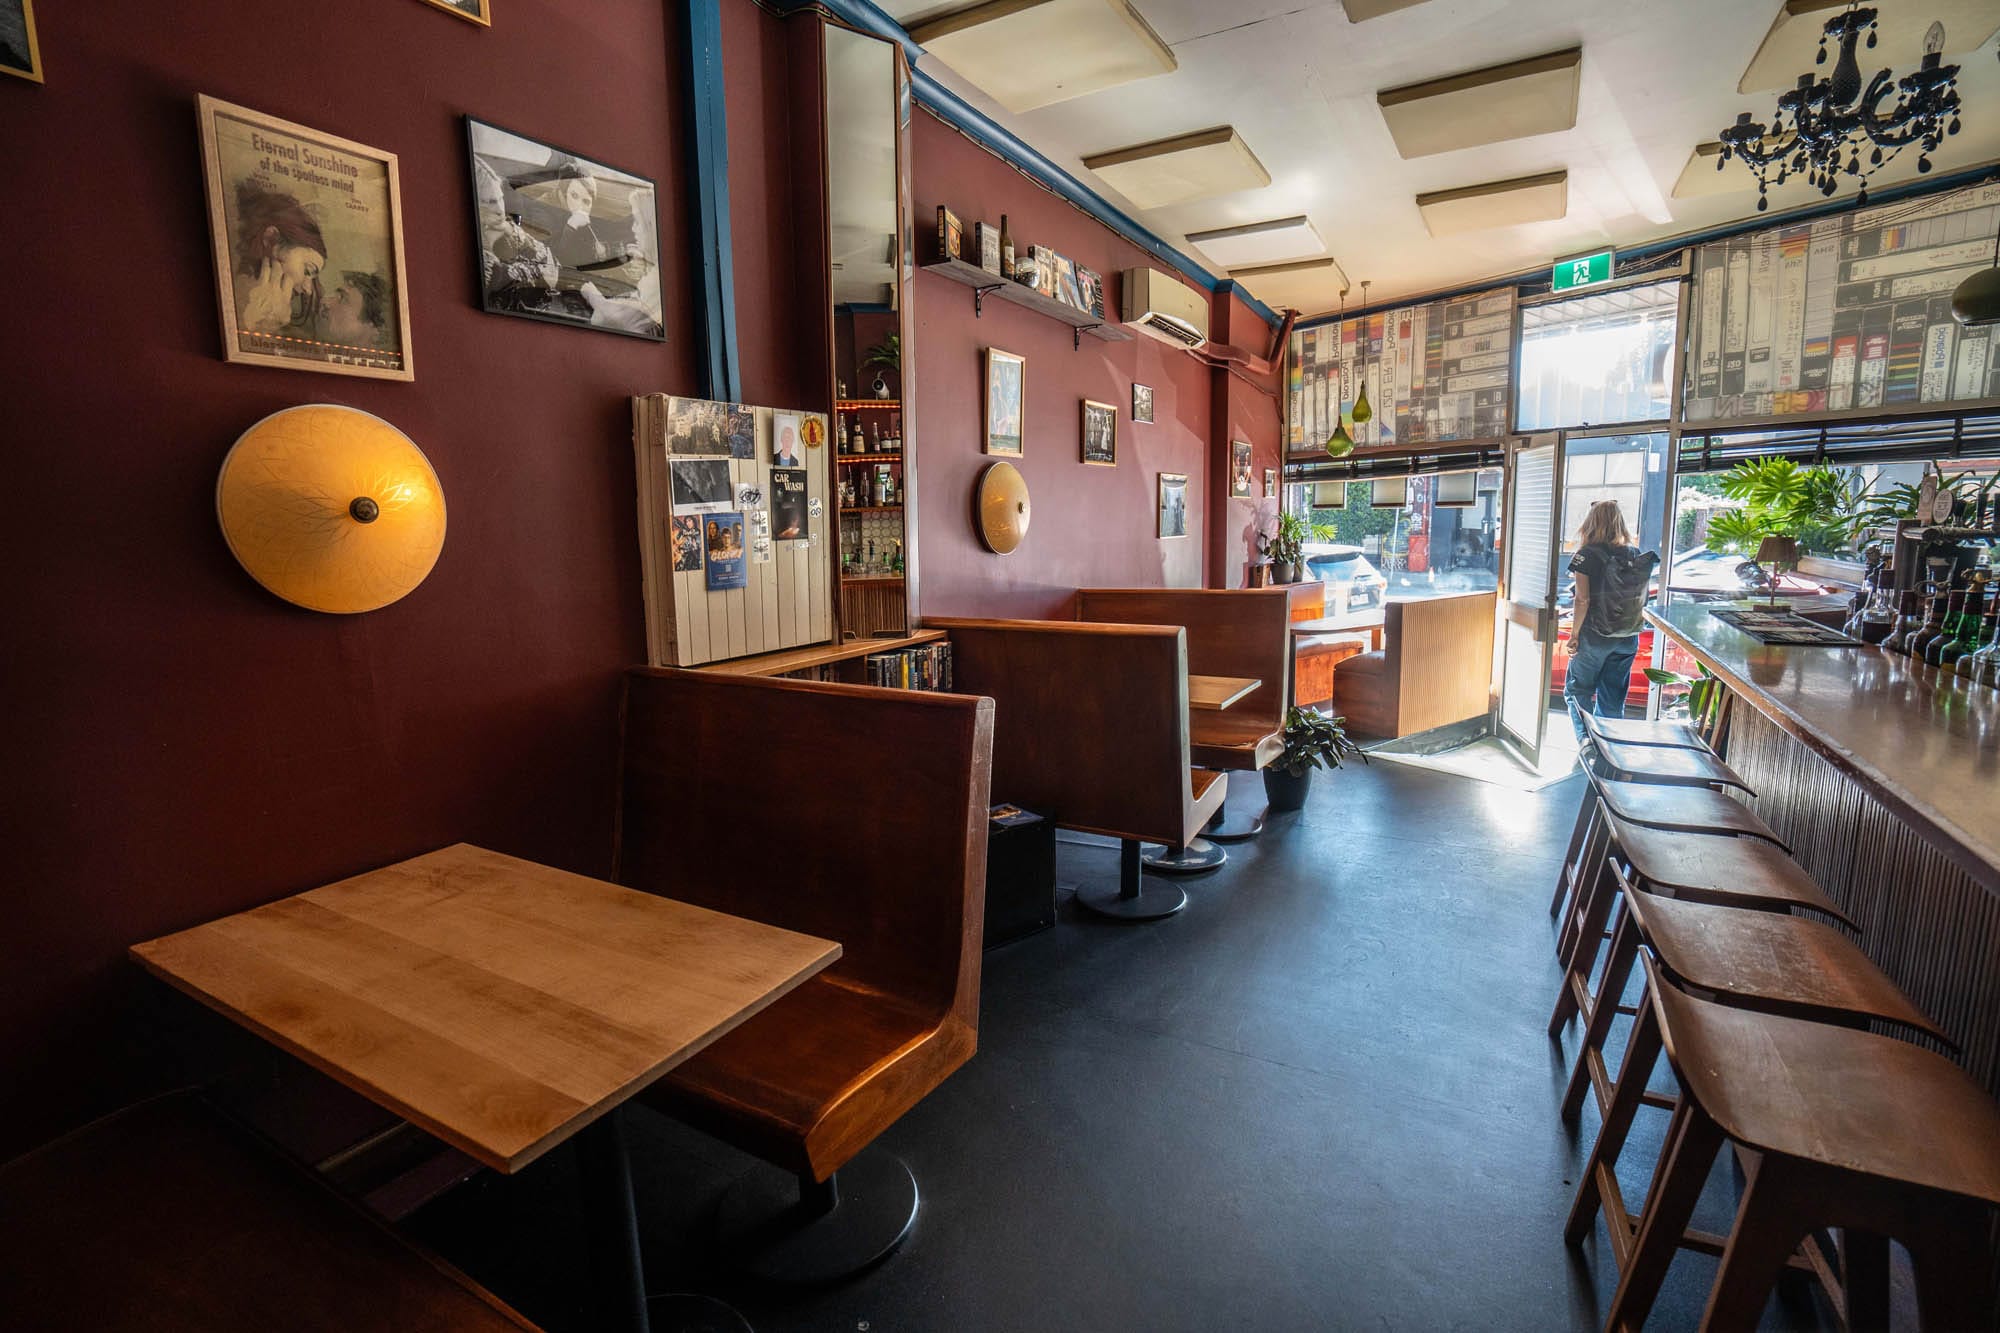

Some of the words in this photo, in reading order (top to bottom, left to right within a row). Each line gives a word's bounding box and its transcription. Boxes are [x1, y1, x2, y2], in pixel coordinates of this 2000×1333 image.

[252, 133, 298, 161] Eternal
[302, 147, 358, 178] Sunshine
[260, 157, 270, 170] of
[273, 160, 289, 176] the
[292, 168, 329, 187] spotless
[332, 179, 355, 193] mind
[774, 473, 790, 483] CAR
[783, 482, 804, 492] WASH
